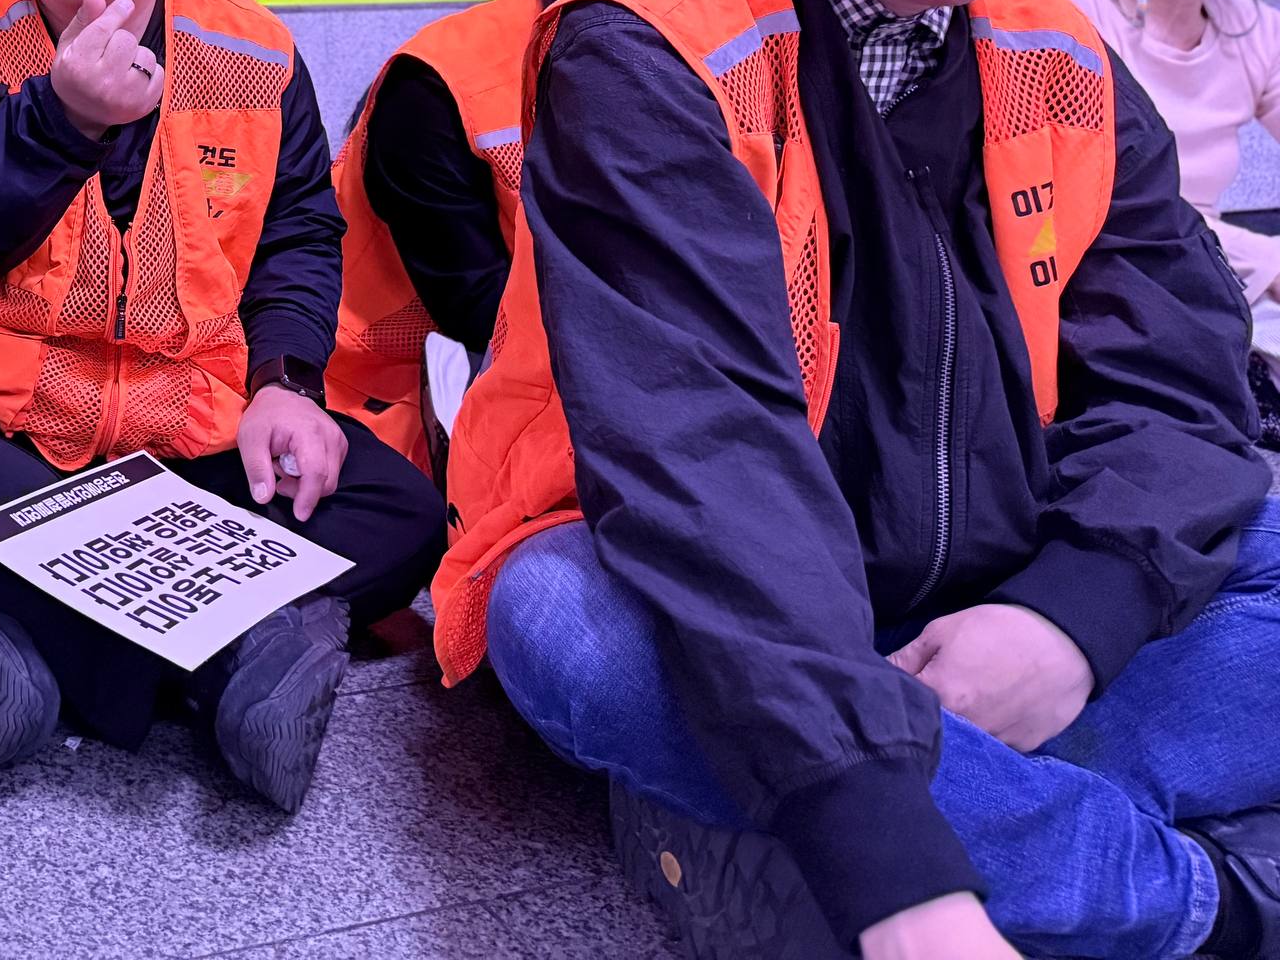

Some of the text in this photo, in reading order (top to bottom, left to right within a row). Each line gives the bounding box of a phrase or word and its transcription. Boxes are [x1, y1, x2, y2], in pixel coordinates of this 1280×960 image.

[10, 470, 130, 527] 전국장애인차별철폐연대
[38, 499, 219, 586] 복원은 책임이다
[80, 518, 257, 611] 해고는 살인이다
[124, 538, 297, 635] 이것도 노동이다
